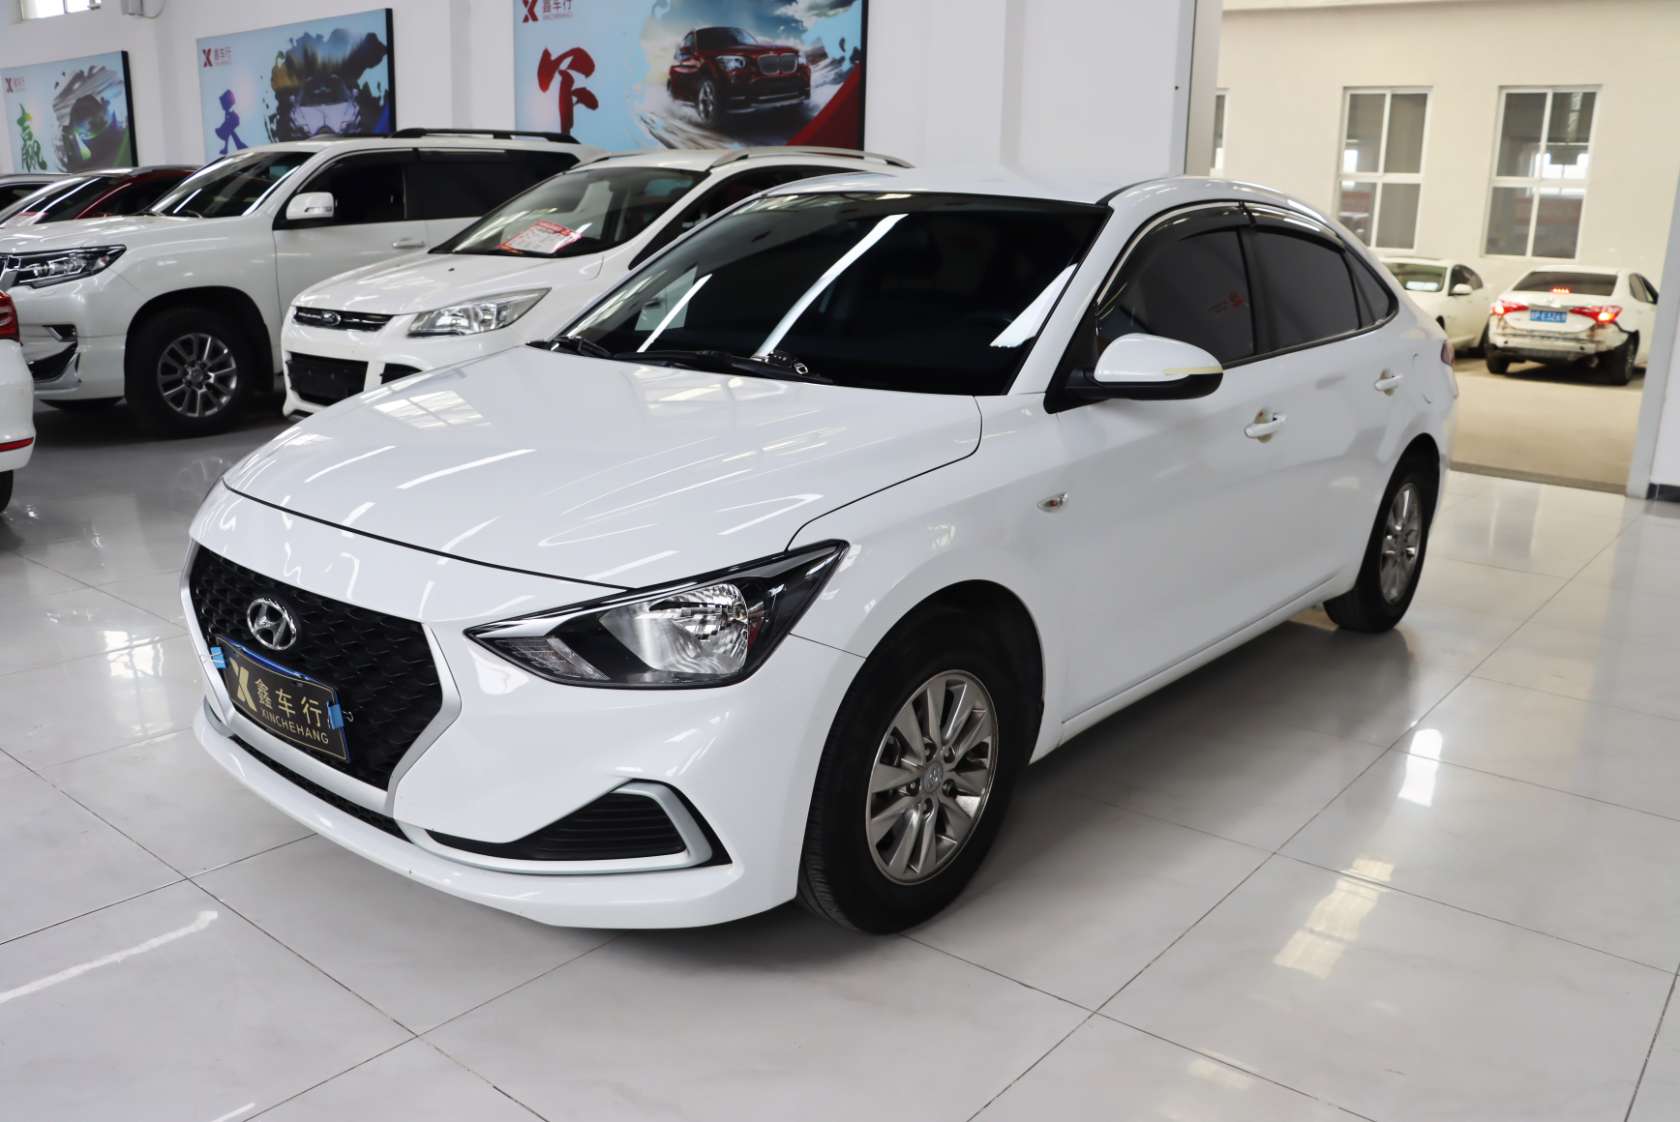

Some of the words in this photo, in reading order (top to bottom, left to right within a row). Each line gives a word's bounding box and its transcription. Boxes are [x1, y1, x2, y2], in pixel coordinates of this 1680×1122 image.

[255, 678, 322, 728] 鑫车行
[261, 708, 329, 744] XINCHEHANG
